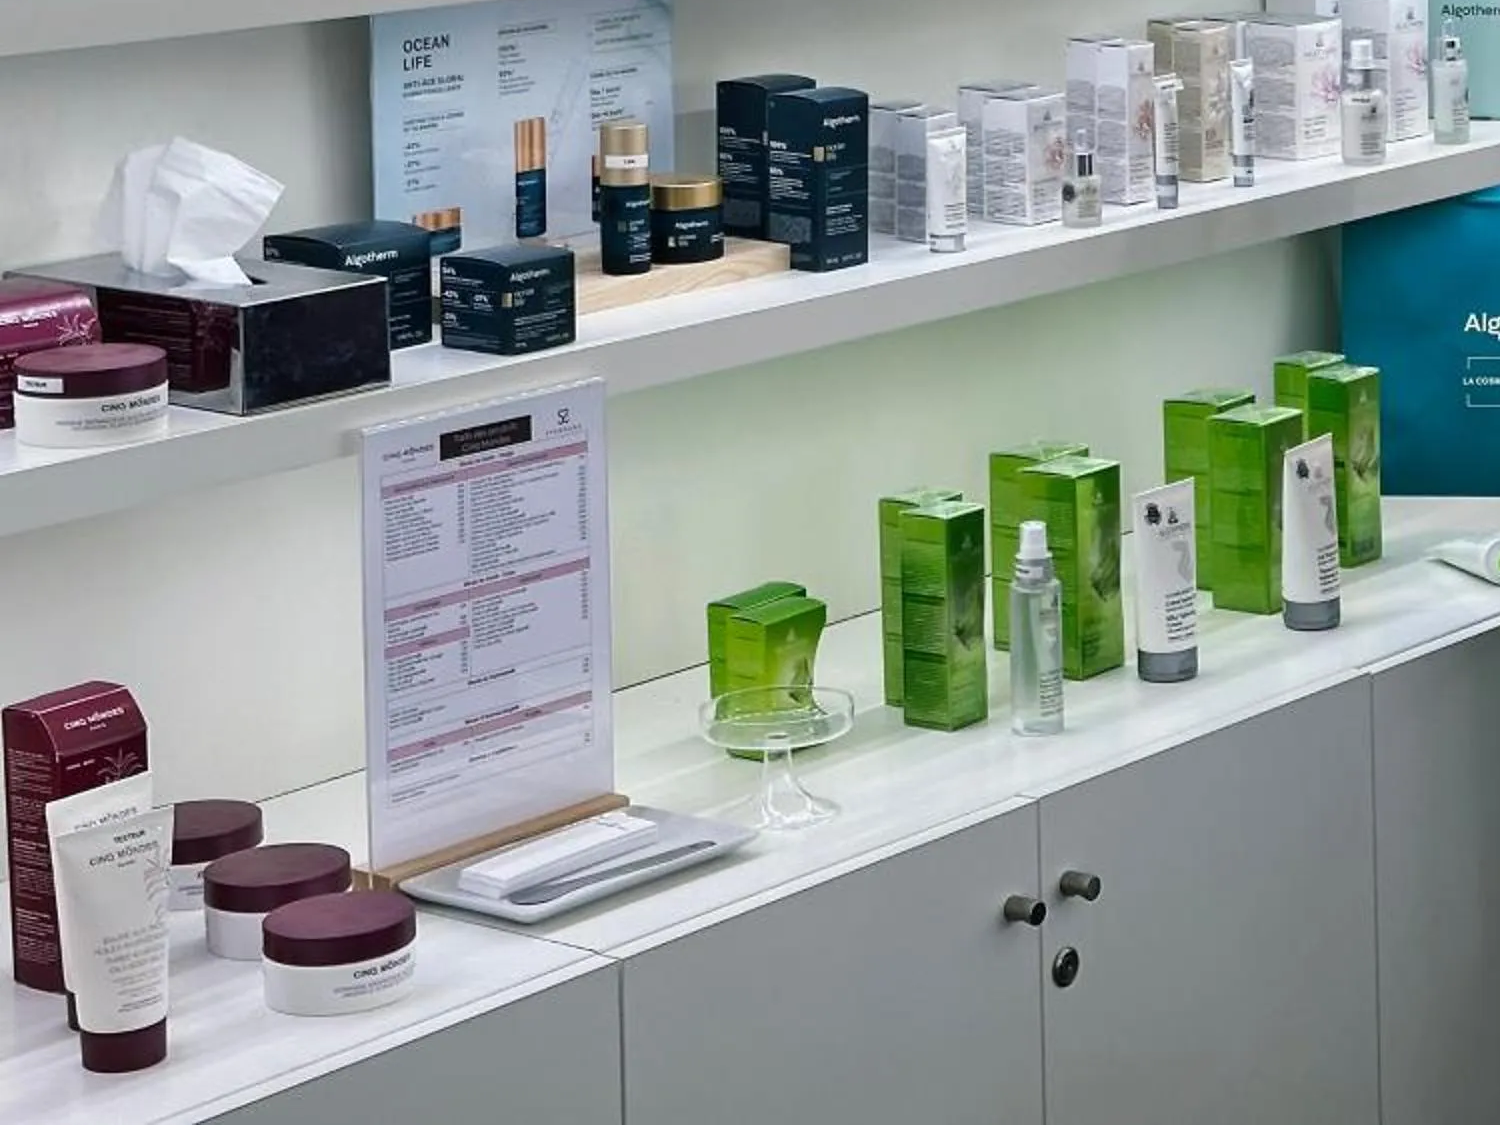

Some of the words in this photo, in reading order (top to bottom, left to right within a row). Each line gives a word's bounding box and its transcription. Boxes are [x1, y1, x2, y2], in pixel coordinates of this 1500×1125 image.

[403, 34, 450, 54] OCEAN
[403, 54, 433, 72] LIFE
[344, 249, 399, 268] Algotherm
[1462, 376, 1475, 386] LA
[89, 853, 115, 867] CINQ
[353, 966, 379, 980] CINQ
